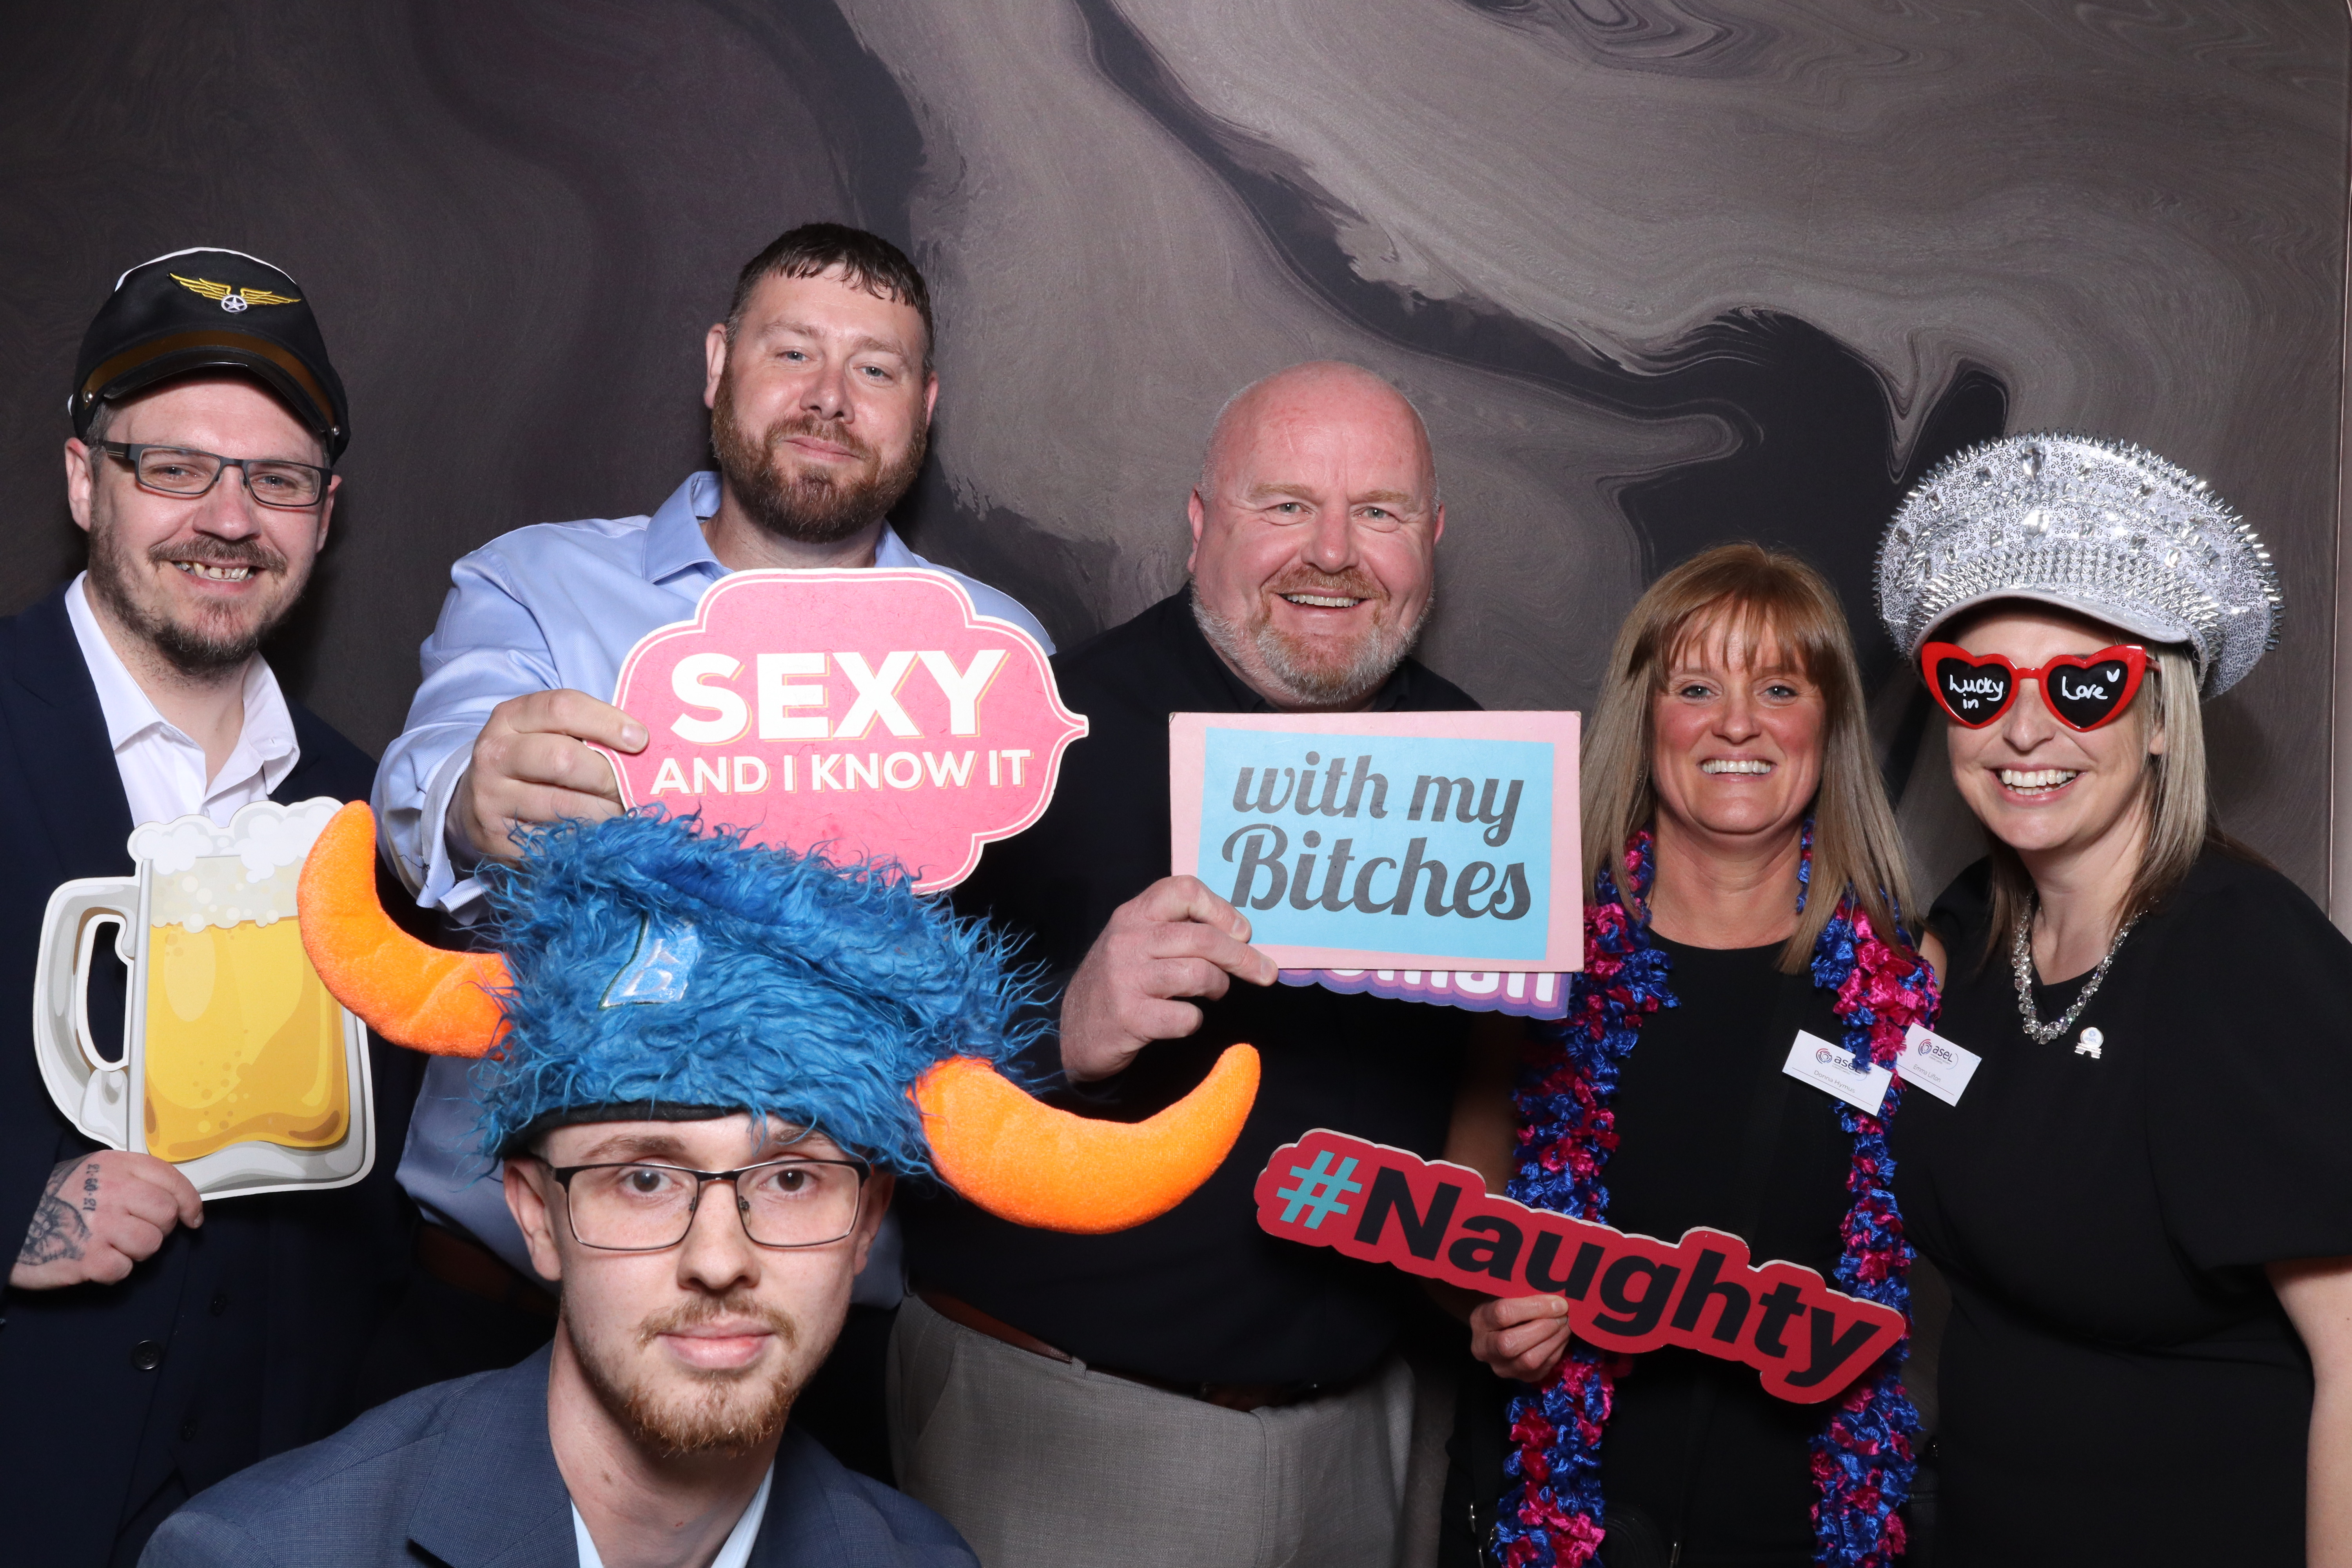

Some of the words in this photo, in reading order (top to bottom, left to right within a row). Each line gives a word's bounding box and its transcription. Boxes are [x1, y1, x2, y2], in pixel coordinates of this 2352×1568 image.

[670, 649, 1011, 745] SEXY
[1949, 674, 2004, 702] Lucky
[1962, 693, 1979, 710] in
[2062, 676, 2108, 701] Love
[649, 755, 771, 796] AND
[784, 753, 797, 792] I
[811, 750, 978, 793] KNOW
[989, 749, 1034, 788] IT
[1232, 751, 1388, 819] with
[1407, 775, 1524, 847] my
[1221, 823, 1531, 920] Bitches
[1814, 1070, 1833, 1082] Donna
[1835, 1080, 1856, 1093] Hymus
[1913, 1063, 1927, 1075] Emma
[1276, 1149, 1881, 1387] #Naughty
